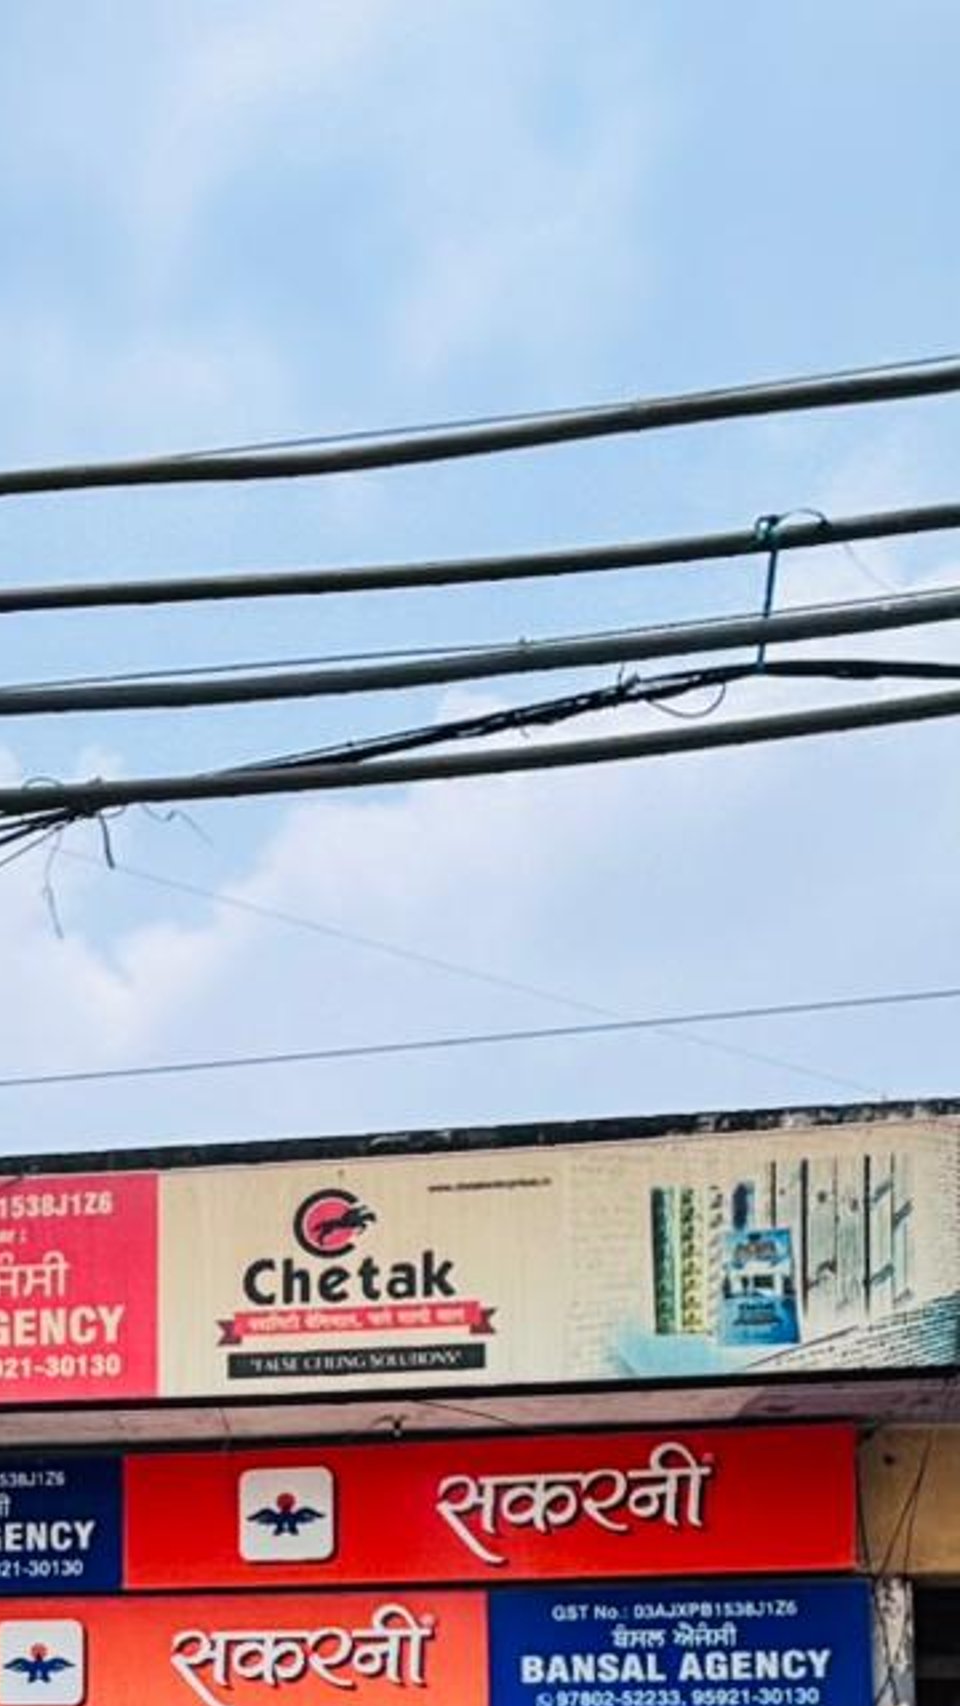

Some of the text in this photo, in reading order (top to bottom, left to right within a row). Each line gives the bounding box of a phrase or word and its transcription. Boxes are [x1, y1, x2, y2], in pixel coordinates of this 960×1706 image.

[243, 1250, 456, 1305] Chetak
[436, 1441, 712, 1565] सकरनी
[551, 1604, 589, 1622] GST
[520, 1649, 832, 1684] BANSAL AGENCY
[692, 1687, 820, 1706] 95921-30130
